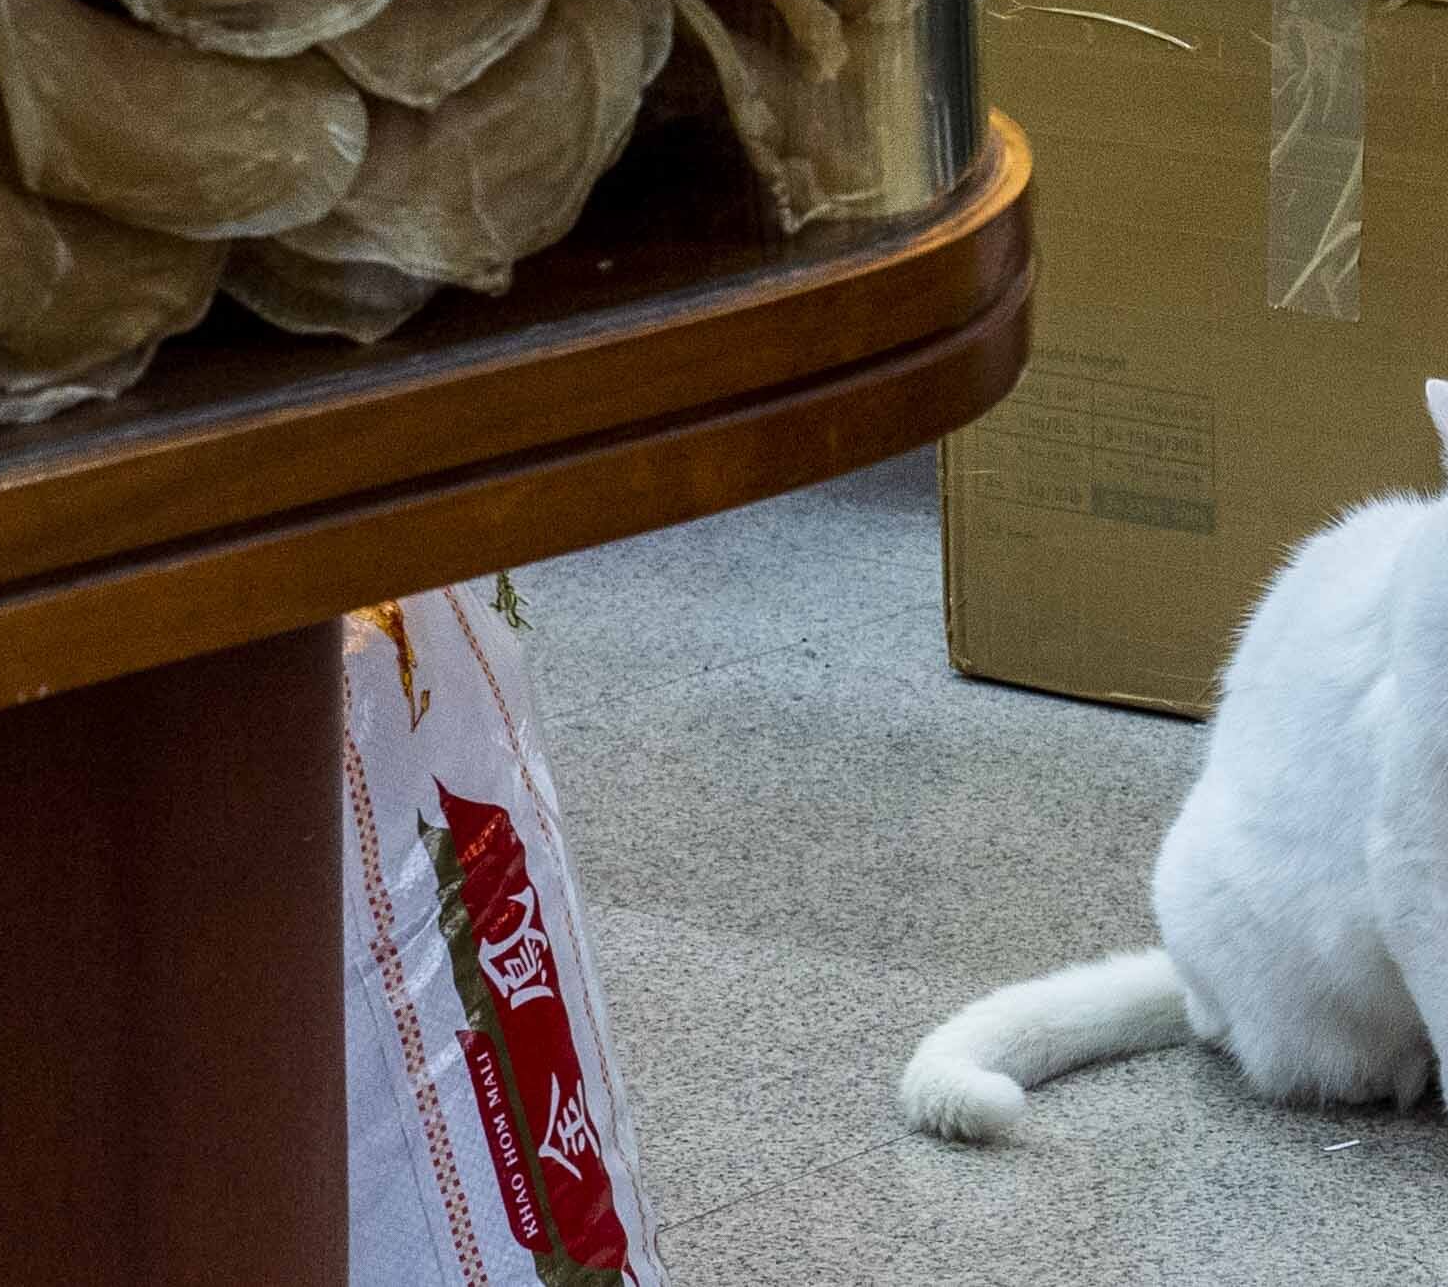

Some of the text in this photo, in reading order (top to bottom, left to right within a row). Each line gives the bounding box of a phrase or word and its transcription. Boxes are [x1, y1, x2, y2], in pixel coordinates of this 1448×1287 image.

[476, 1054, 539, 1240] KHAO HOM MALI
